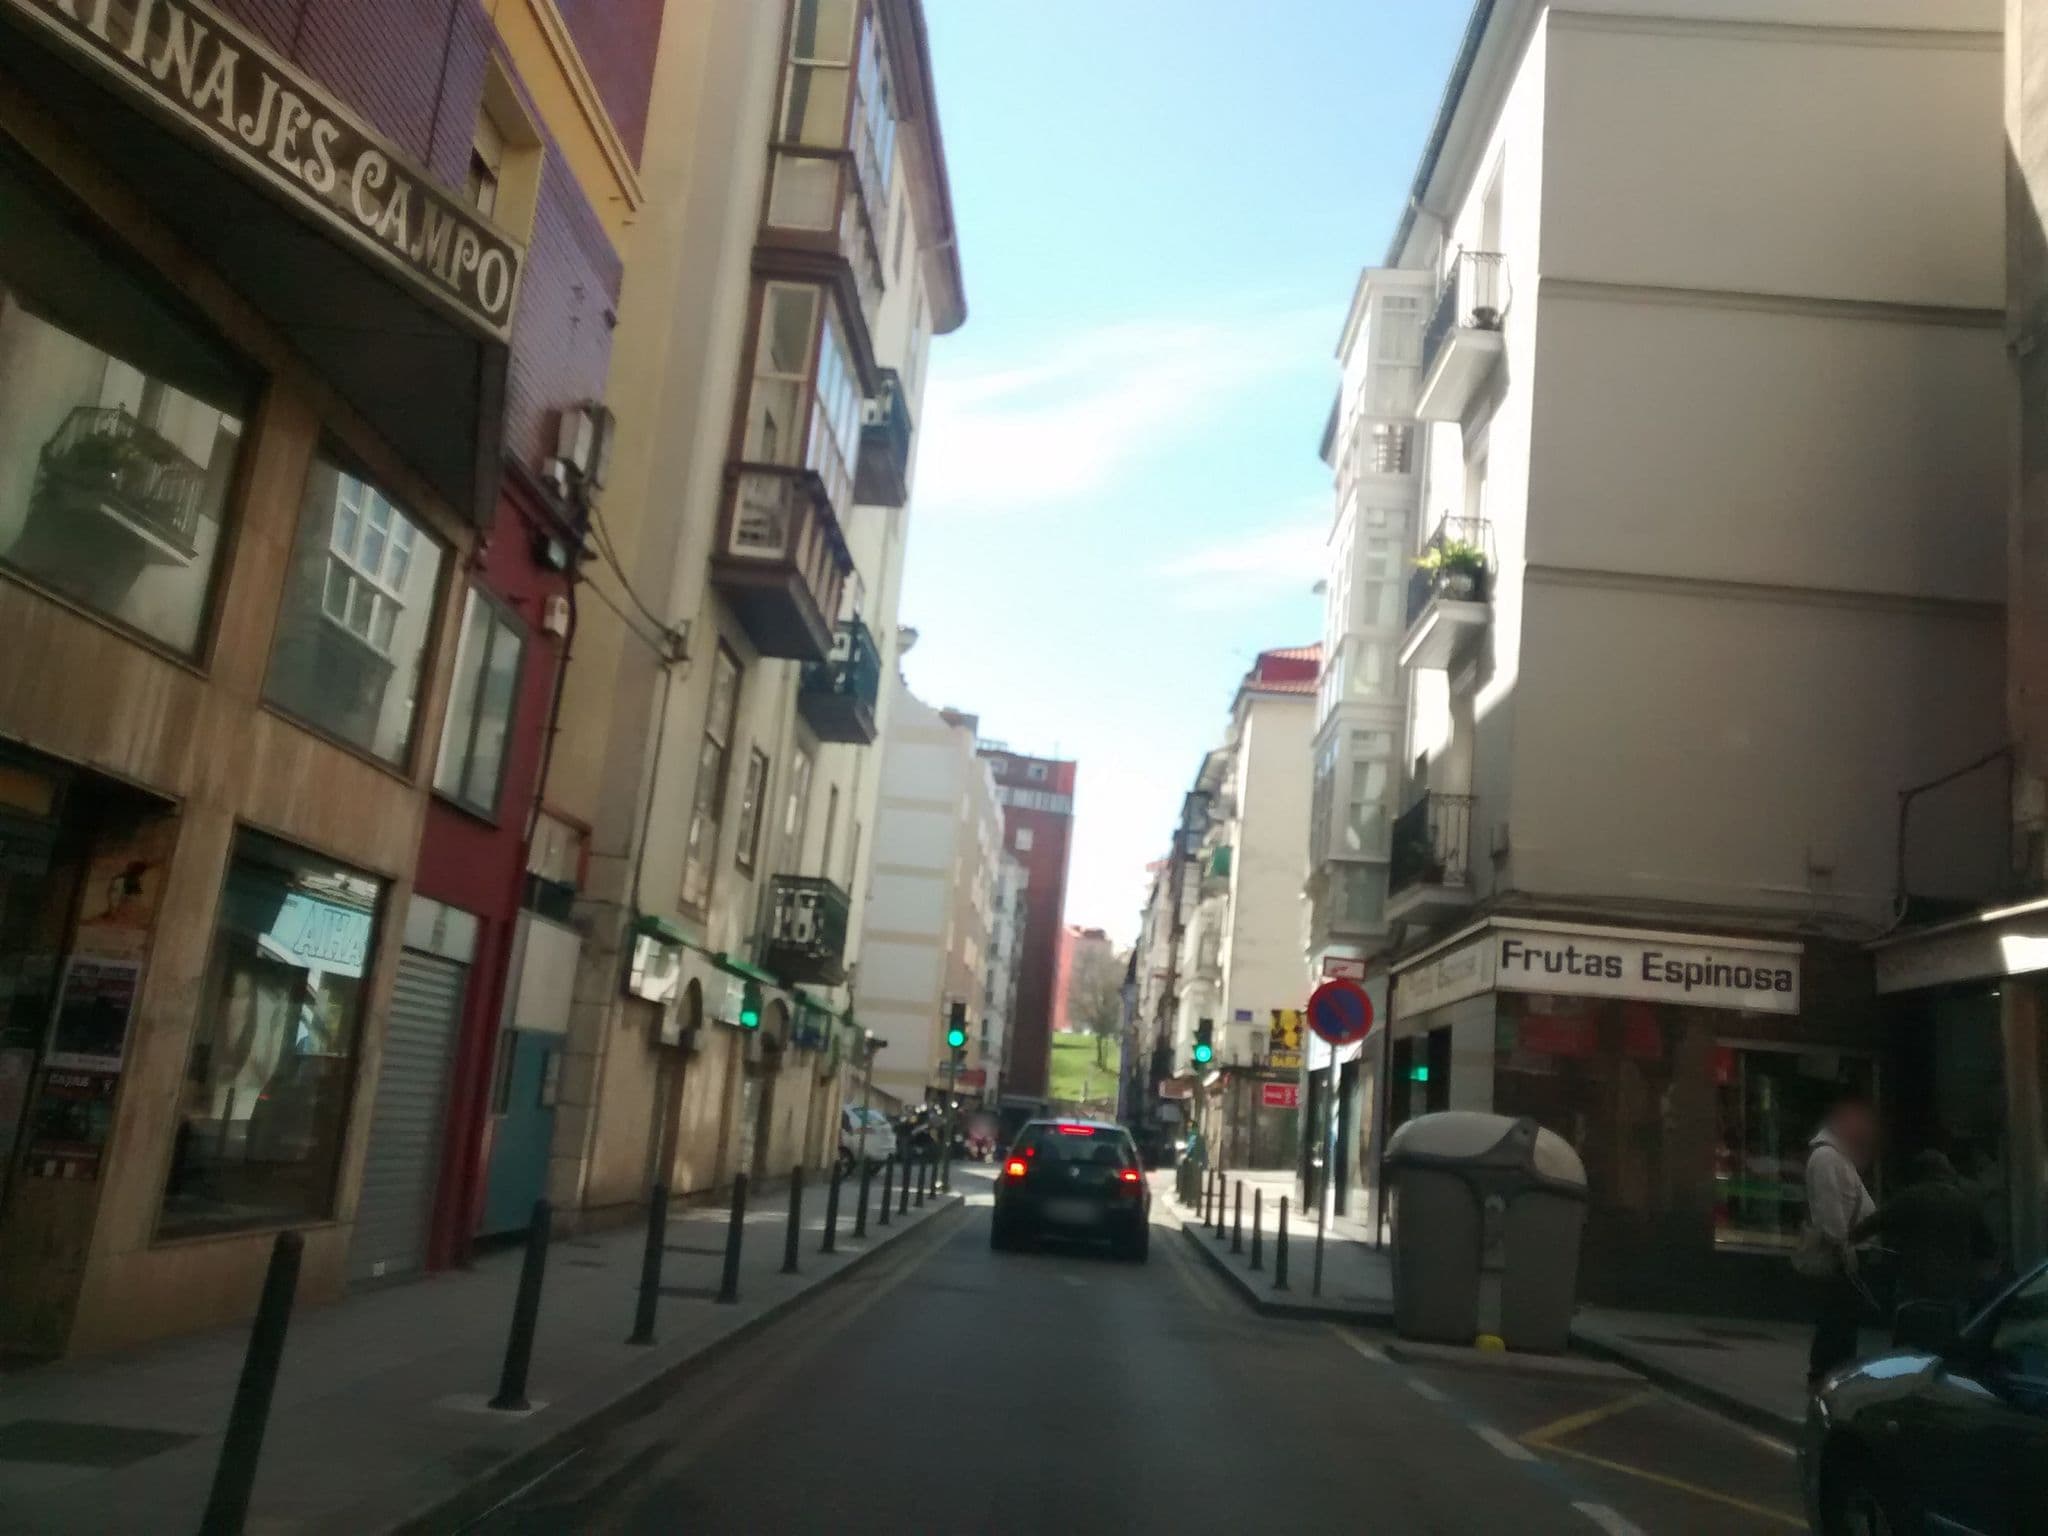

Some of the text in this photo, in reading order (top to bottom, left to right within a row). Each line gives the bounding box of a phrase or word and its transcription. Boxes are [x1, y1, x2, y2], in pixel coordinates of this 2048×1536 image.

[56, 0, 509, 313] INAJES CAMPO
[1502, 940, 1622, 978] Frutas
[1642, 952, 1793, 992] Espinosa
